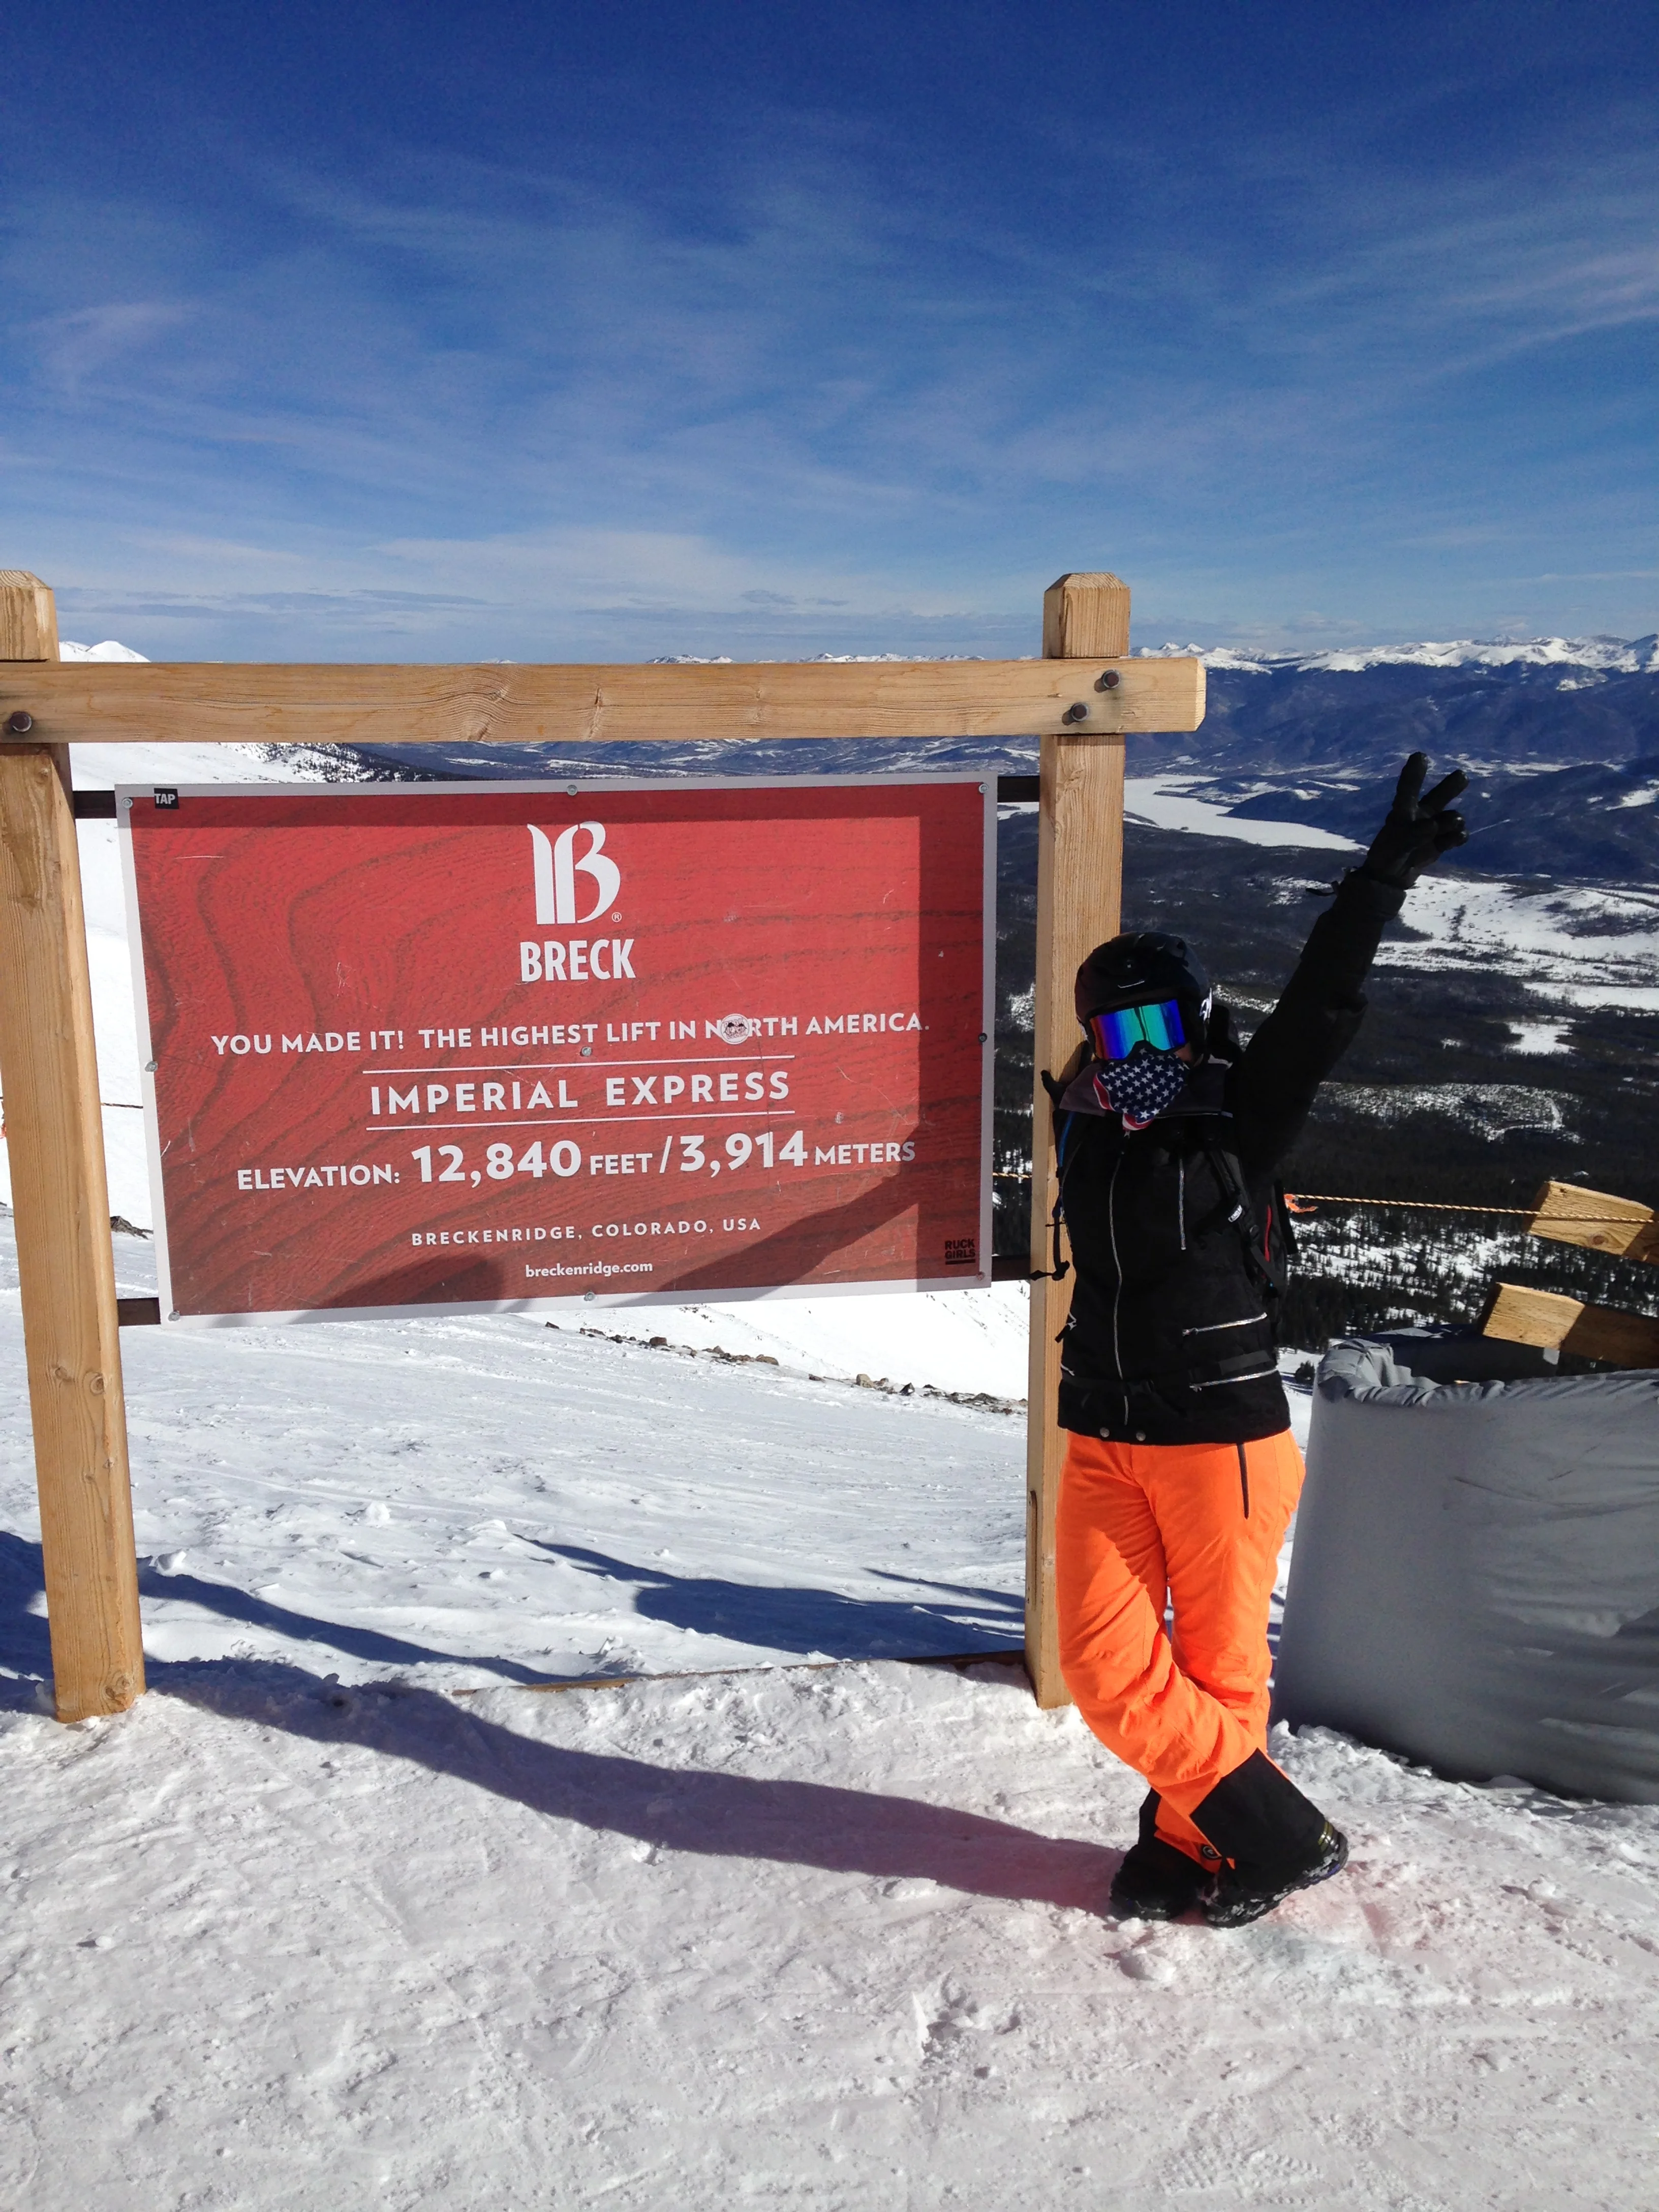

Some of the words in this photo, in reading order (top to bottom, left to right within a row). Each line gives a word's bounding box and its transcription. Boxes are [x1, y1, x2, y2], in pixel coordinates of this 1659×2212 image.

[154, 793, 175, 804] TAP
[519, 938, 636, 982] BRECK
[210, 1034, 272, 1055] YOU
[281, 1031, 361, 1053] MADE
[370, 1030, 404, 1051] IT!
[418, 1028, 472, 1049] THE
[480, 1023, 599, 1048] HIGHEST
[606, 1021, 661, 1042] LIFT
[669, 1020, 696, 1040] IN
[705, 1017, 798, 1039] NRTH
[805, 1012, 930, 1036] AMERICA.
[371, 1079, 578, 1115] IMPERIAL
[606, 1070, 789, 1107] EXPRESS
[237, 1163, 401, 1190] ELEVATION:
[411, 1140, 582, 1188] 12,840
[590, 1153, 653, 1176] FEET
[814, 1141, 915, 1166] METERS
[411, 1225, 582, 1246] BRECKENRIDGE,
[592, 1220, 714, 1238] COLORADO,
[723, 1218, 761, 1232] USA
[944, 1239, 975, 1250] RUCK
[944, 1248, 975, 1259] GIRLS
[525, 1261, 653, 1278] breckenridge.com
